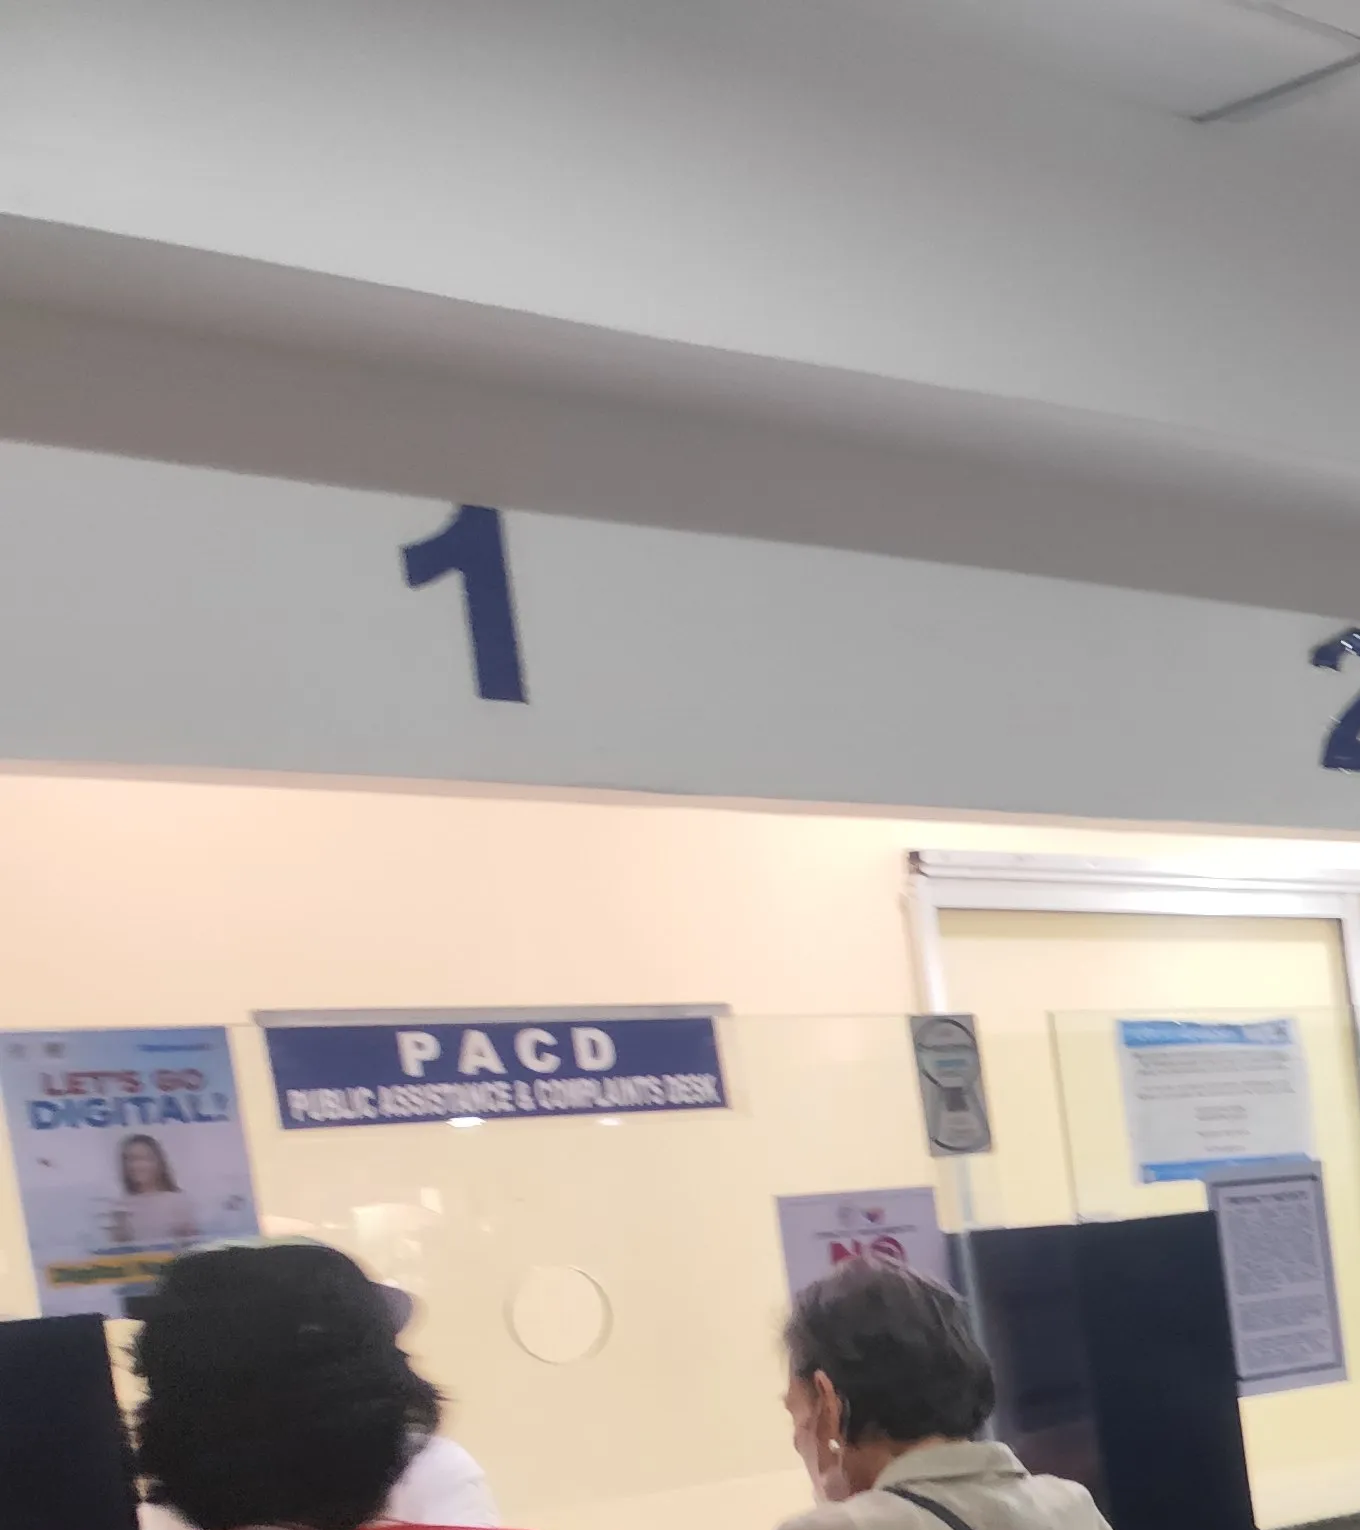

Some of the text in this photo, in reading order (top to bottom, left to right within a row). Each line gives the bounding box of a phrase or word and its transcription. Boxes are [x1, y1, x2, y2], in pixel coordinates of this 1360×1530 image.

[402, 503, 528, 704] 1
[286, 1087, 377, 1122] PUBLIC
[377, 1080, 513, 1117] ASSISTANCE
[534, 1076, 664, 1110] COMPLAINTS
[663, 1073, 721, 1103] DESK
